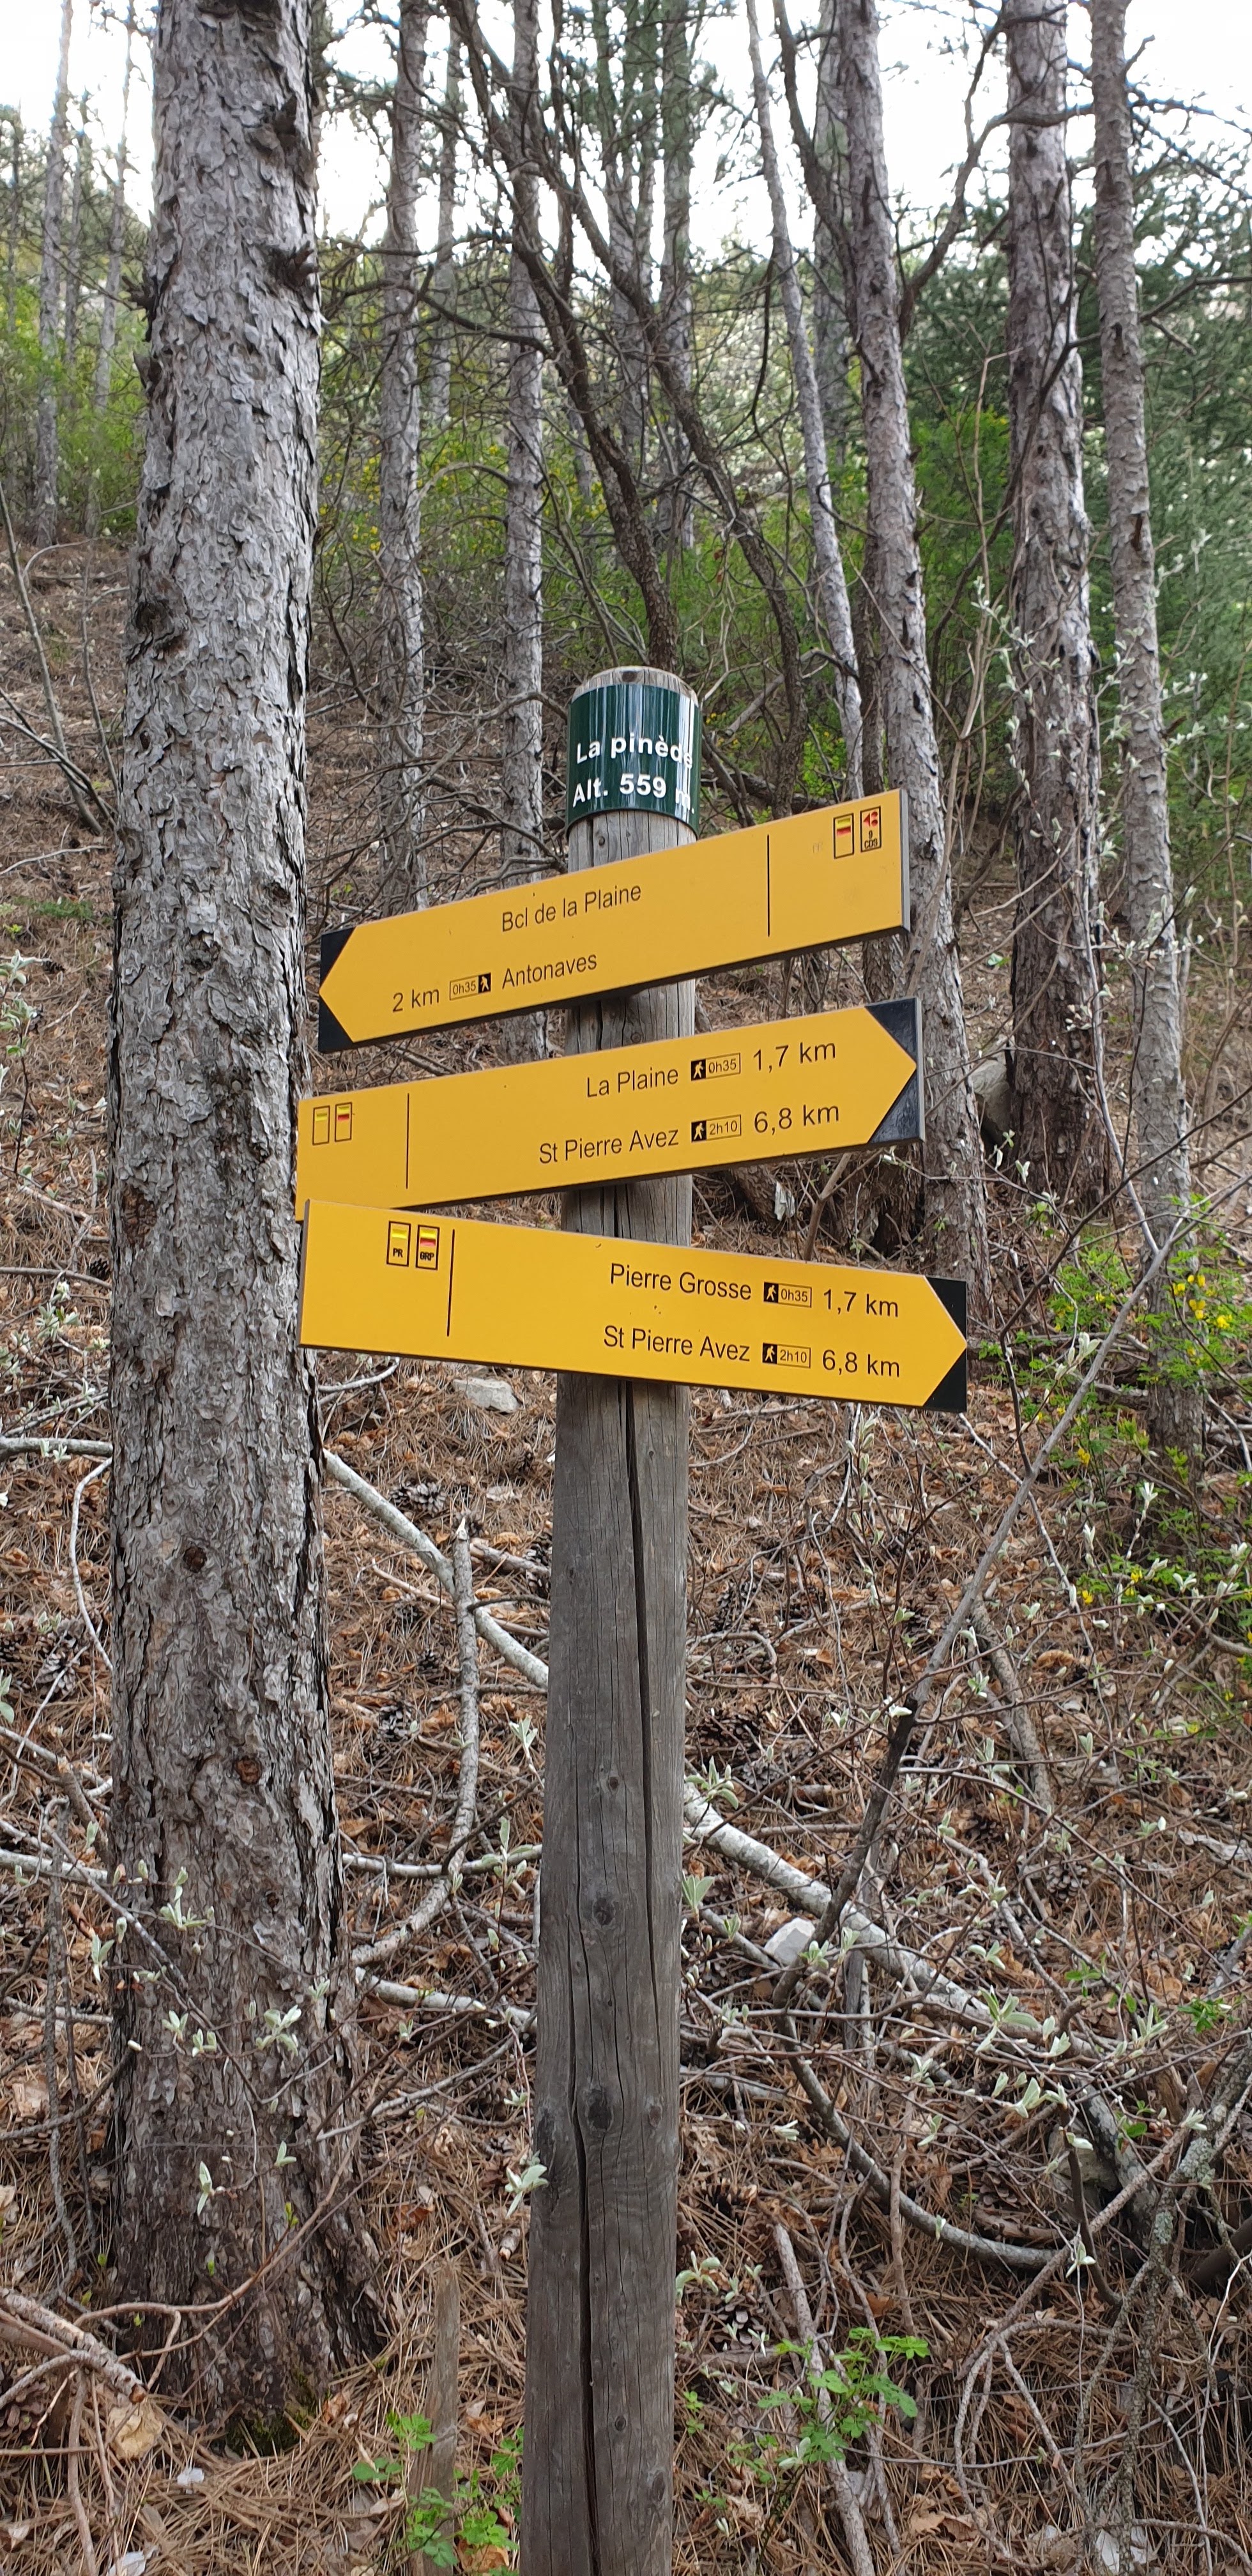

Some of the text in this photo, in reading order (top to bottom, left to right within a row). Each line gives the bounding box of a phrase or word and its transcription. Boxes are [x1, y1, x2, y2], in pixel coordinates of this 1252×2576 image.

[577, 732, 693, 769] La pinède
[572, 777, 608, 808] Alt.
[620, 773, 667, 799] 559
[502, 885, 641, 932] Bcl de la Plaine
[392, 954, 597, 1013] 2 km 0h35 Antonaves
[587, 1041, 836, 1098] La Plaine 0h35 1,7 km
[539, 1104, 839, 1164] St Pierre Avez 2h10 6,8 km
[392, 1248, 403, 1258] PR
[420, 1252, 434, 1261] GRP
[611, 1262, 898, 1317] Pierre Grosse 0h35 1,7 km
[604, 1325, 899, 1377] St Pierre Avez 2h10 6,8 km
